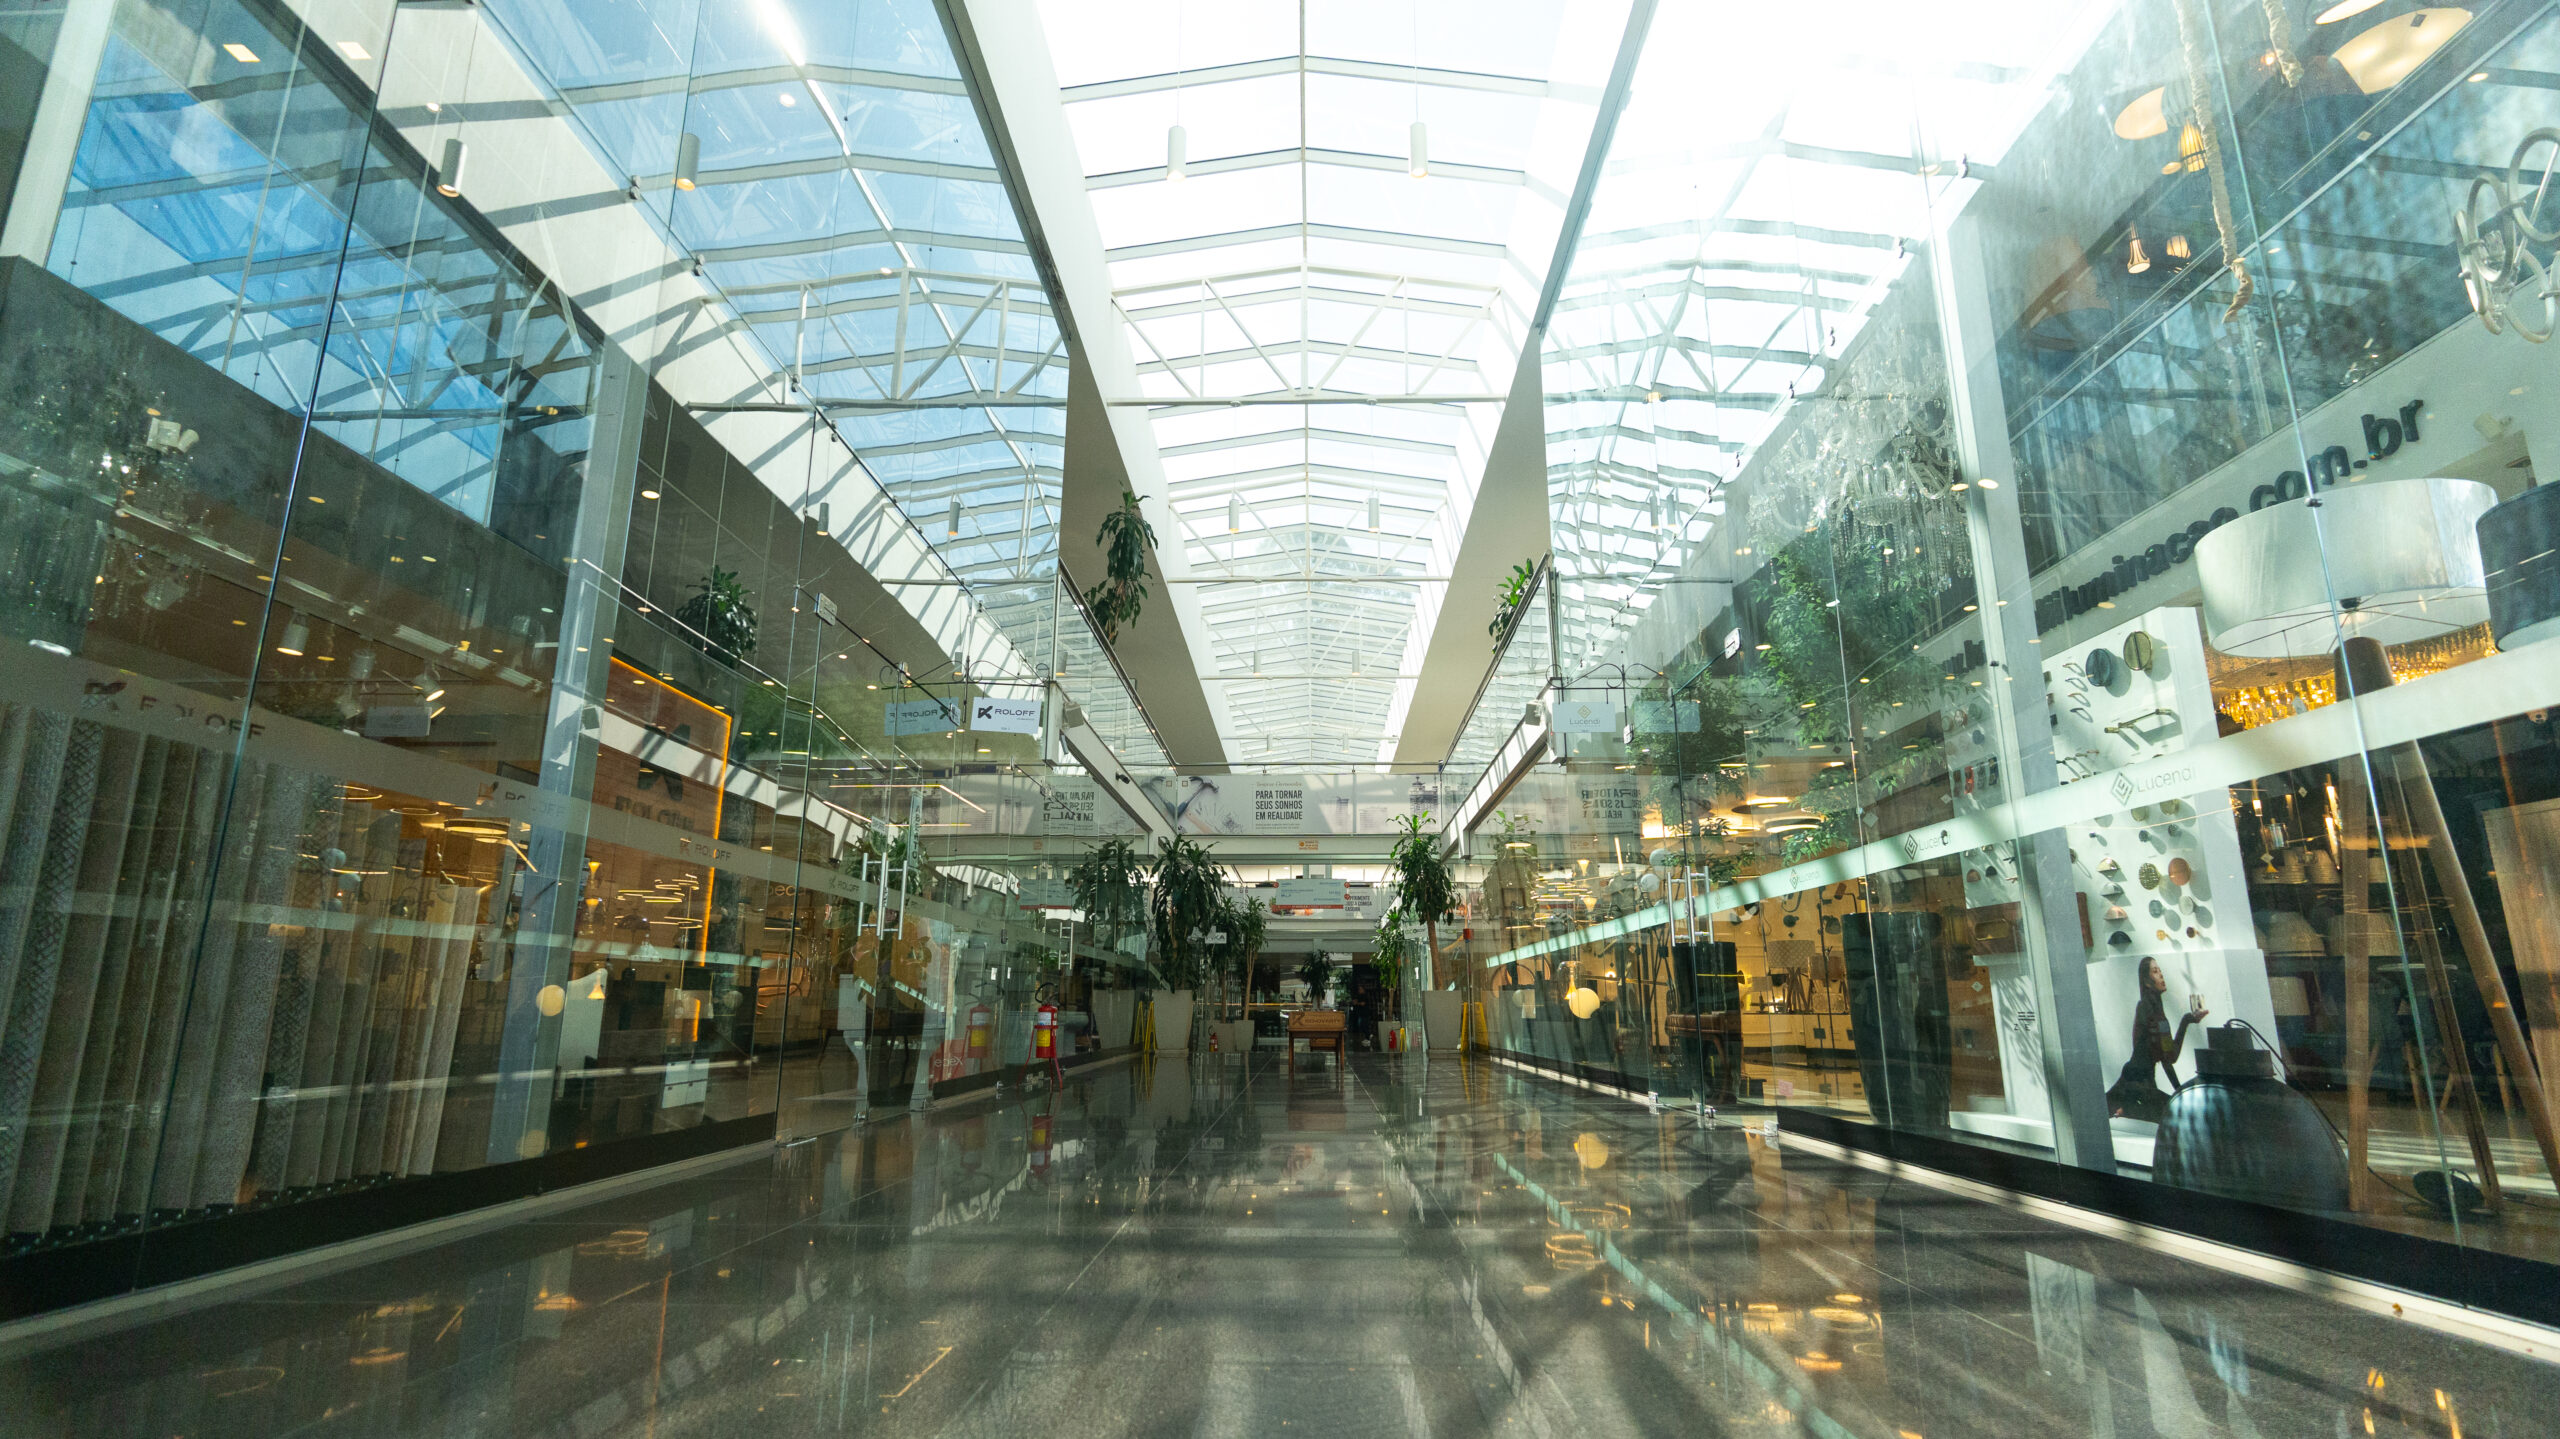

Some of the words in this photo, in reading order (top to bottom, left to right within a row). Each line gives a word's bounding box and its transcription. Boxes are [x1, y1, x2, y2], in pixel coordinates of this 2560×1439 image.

[994, 708, 1036, 717] ROLOFF
[1255, 790, 1273, 800] PARA
[1275, 790, 1303, 800] TORNAR
[1255, 800, 1273, 810] SEUS
[1275, 800, 1303, 810] SONHOS
[1255, 811, 1266, 820] EM
[1267, 811, 1303, 820] REALIDADE
